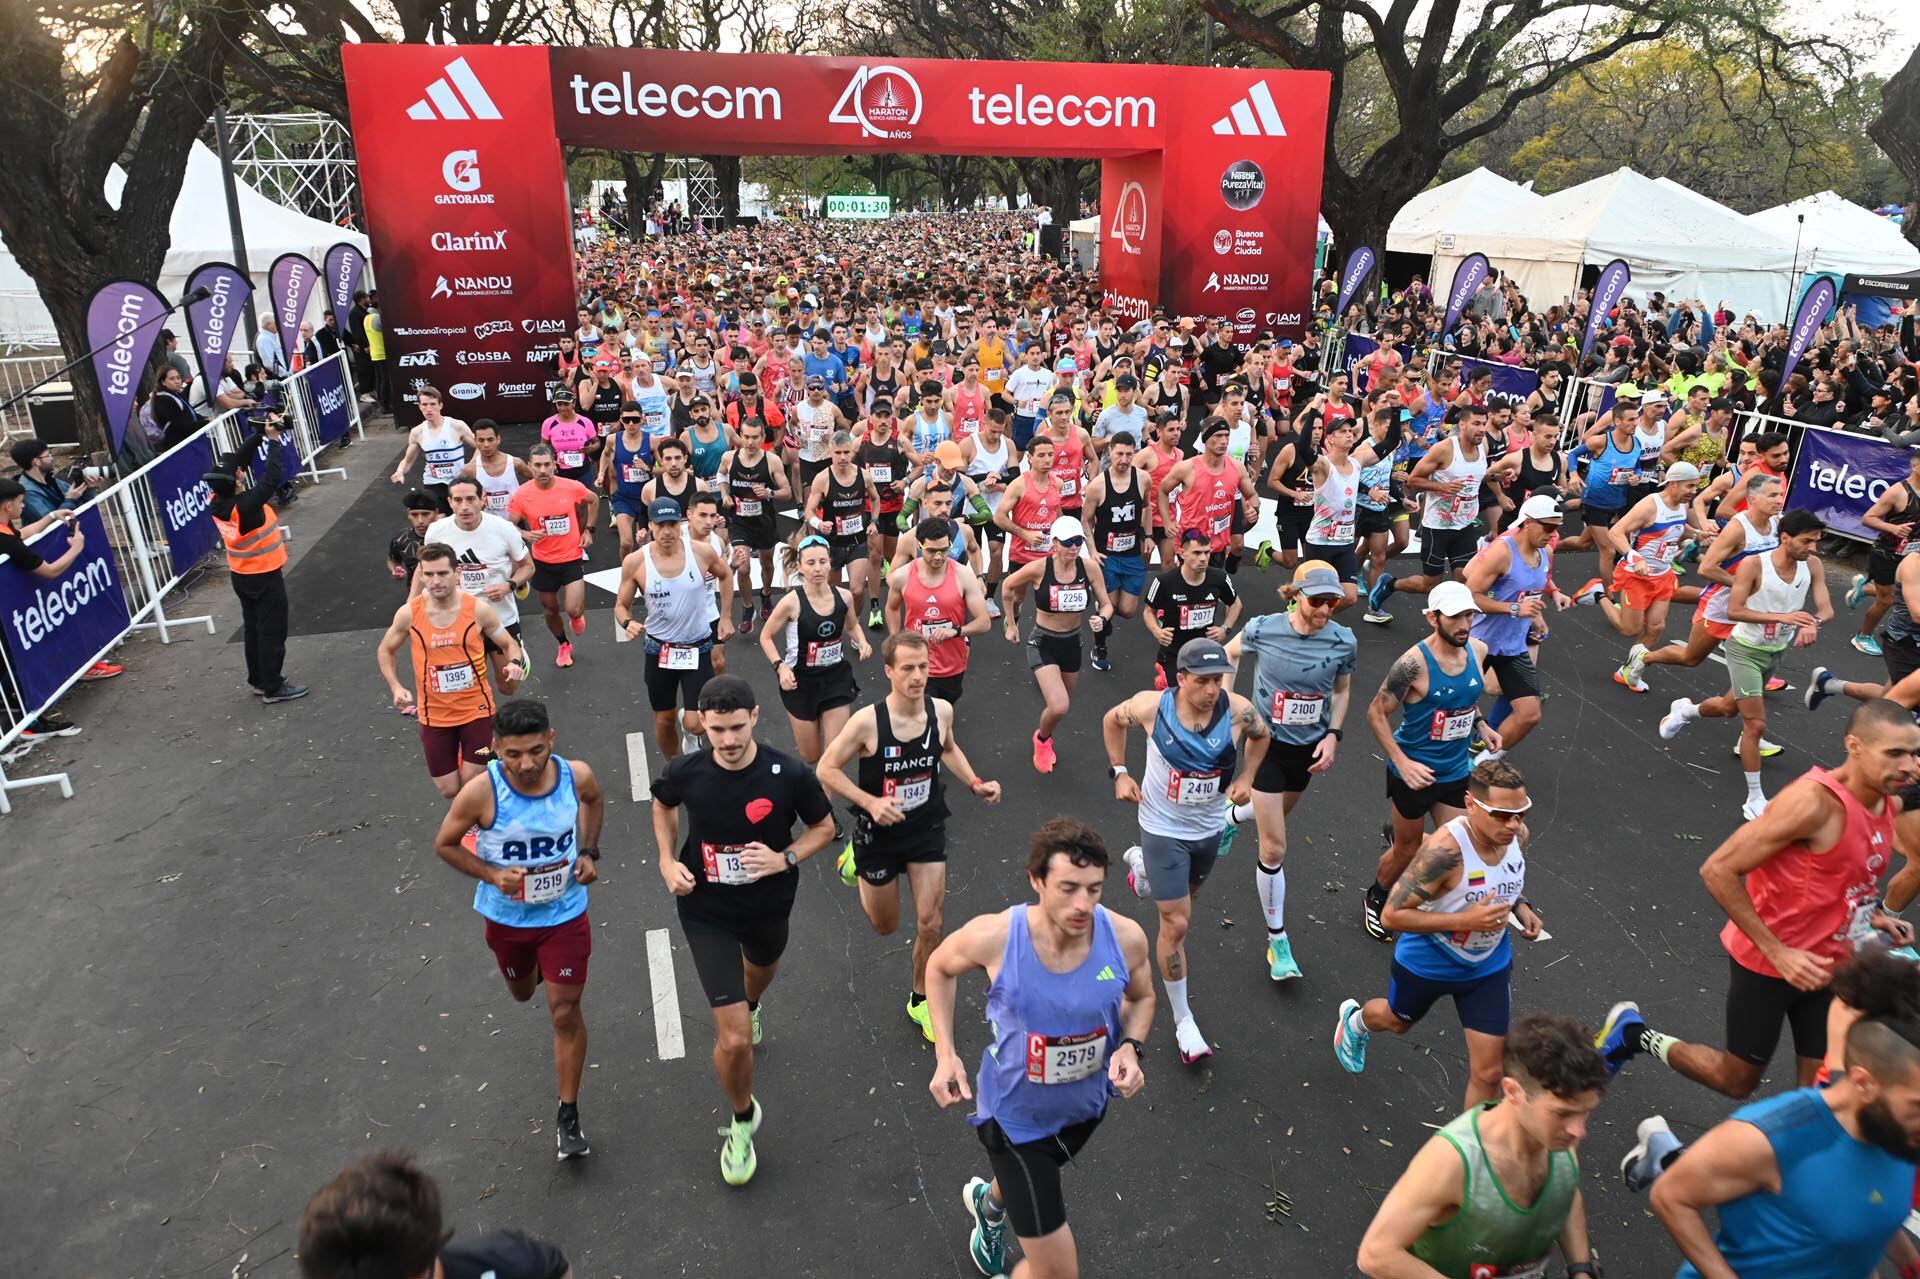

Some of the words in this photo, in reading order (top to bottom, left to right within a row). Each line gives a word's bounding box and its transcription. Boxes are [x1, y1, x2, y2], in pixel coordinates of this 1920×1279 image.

[570, 71, 781, 120] telecom
[968, 84, 1156, 128] telecom
[889, 130, 912, 139] AÑOS
[434, 194, 495, 204] GATORADE
[829, 201, 888, 212] 00:01:30
[1235, 230, 1264, 238] Buenos
[431, 231, 496, 251] Clarín
[1235, 239, 1256, 247] Aires
[1234, 247, 1262, 255] Ciudad
[336, 252, 353, 306] telecom
[1343, 251, 1370, 296] telecom
[1451, 261, 1482, 312] telecom
[283, 263, 304, 328] telecom
[1591, 269, 1623, 330] telecom
[203, 275, 231, 355] telecom
[1277, 313, 1301, 322] IAM
[536, 319, 565, 329] IAM
[1789, 288, 1829, 359] telecom
[107, 293, 144, 396] telecom
[399, 355, 436, 367] ENA
[467, 352, 511, 361] ObSBA
[1205, 501, 1232, 512] telecom
[550, 520, 567, 529] 2222
[463, 572, 485, 581] 16501
[650, 591, 671, 600] TEAM
[1063, 593, 1083, 602] 2256
[13, 556, 112, 650] telecom
[1181, 605, 1187, 617] C
[1193, 611, 1211, 621] 2077
[809, 643, 815, 654] C
[675, 652, 692, 661] 1763
[445, 670, 466, 683] 1395
[1275, 692, 1283, 705] C
[1291, 703, 1316, 714] 2100
[1435, 711, 1444, 724] C
[1450, 715, 1472, 731] 2463
[885, 756, 934, 773] FRANCE
[1171, 771, 1179, 784] C
[886, 780, 894, 794] C
[903, 783, 926, 801] 1343
[1187, 782, 1213, 794] 2410
[704, 845, 714, 861] C
[534, 873, 562, 892] 2519
[1030, 1035, 1043, 1057] C
[1056, 1045, 1096, 1067] 2579
